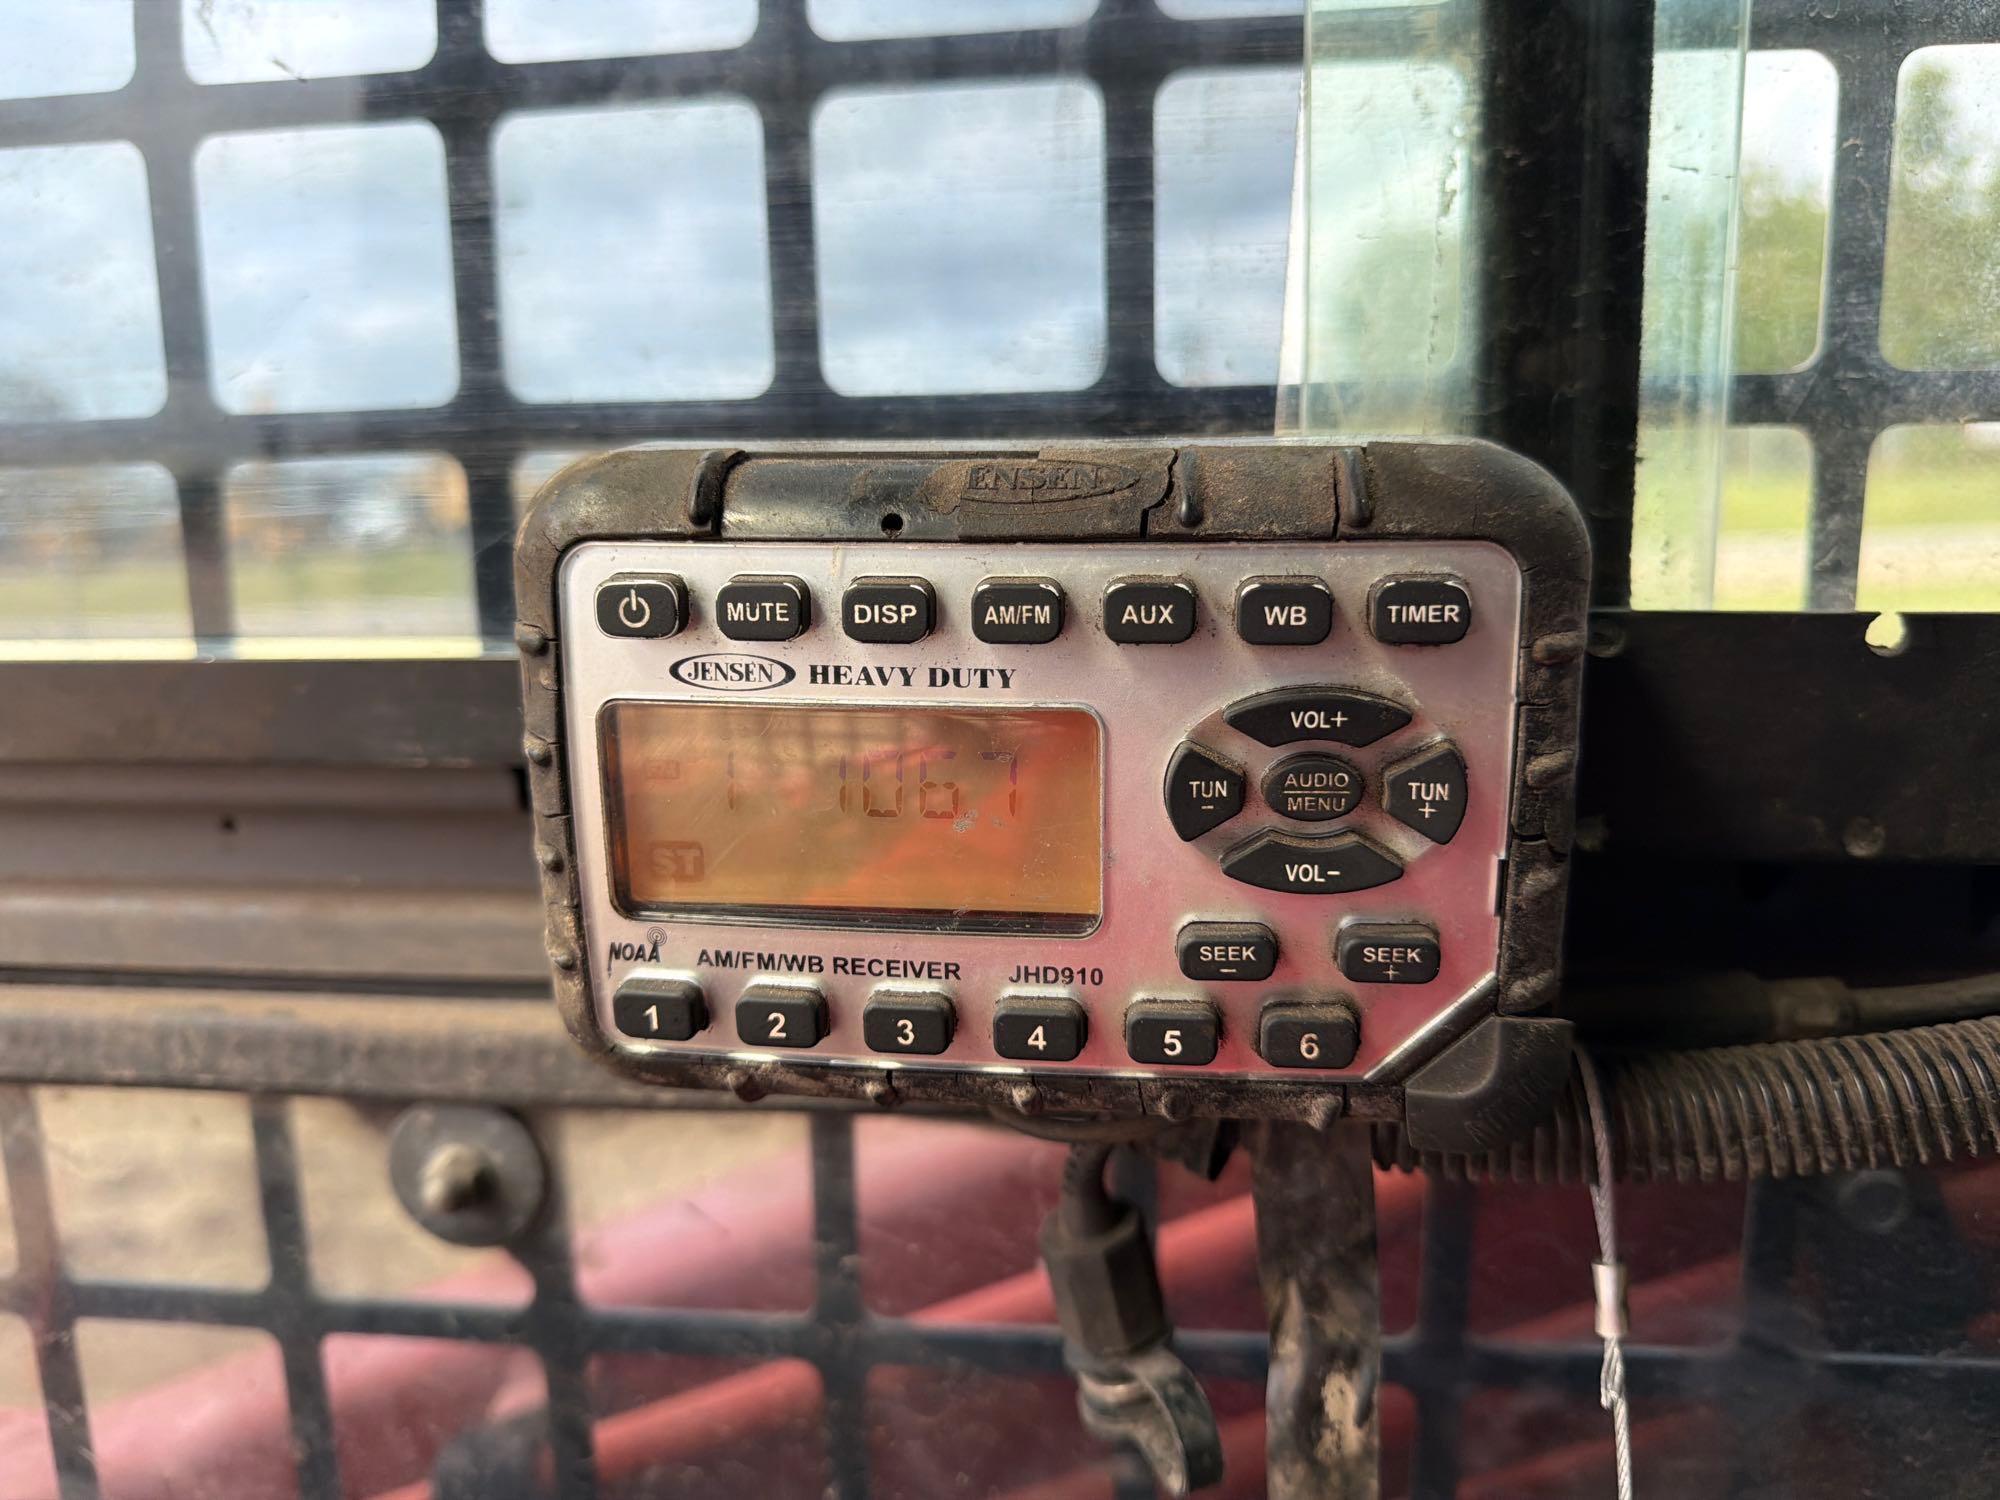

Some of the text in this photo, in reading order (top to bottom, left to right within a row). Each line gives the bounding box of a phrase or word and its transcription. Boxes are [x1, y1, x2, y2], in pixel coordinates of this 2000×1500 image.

[967, 466, 1100, 491] ENSEN
[726, 602, 790, 623] MUTE
[853, 604, 917, 624] DISP
[984, 604, 1051, 625] AM/FM
[1121, 605, 1174, 625] AUX
[1264, 606, 1307, 626] WB
[1387, 604, 1460, 624] TIMER
[687, 660, 774, 684] JENSEN
[809, 664, 1017, 689] HEAVY DUTY
[1290, 710, 1348, 730] VOL+
[1189, 780, 1227, 799] TUN
[1284, 772, 1350, 789] AUDIO
[1408, 782, 1449, 801] TUN
[1286, 797, 1346, 812] MENU
[651, 848, 700, 877] ST
[1285, 864, 1340, 883] VOL-
[608, 940, 661, 975] NOAA
[697, 949, 961, 980] AM/FM/WB RECEIVER
[1200, 947, 1256, 962] SEEK
[1363, 947, 1422, 964] SEEK
[1009, 965, 1104, 986] JHD910
[642, 1005, 659, 1032] 1
[767, 1013, 787, 1040] 2
[897, 1019, 915, 1046] 3
[1027, 1025, 1047, 1051] 4
[1163, 1030, 1182, 1056] 5
[1300, 1033, 1319, 1060] 6
